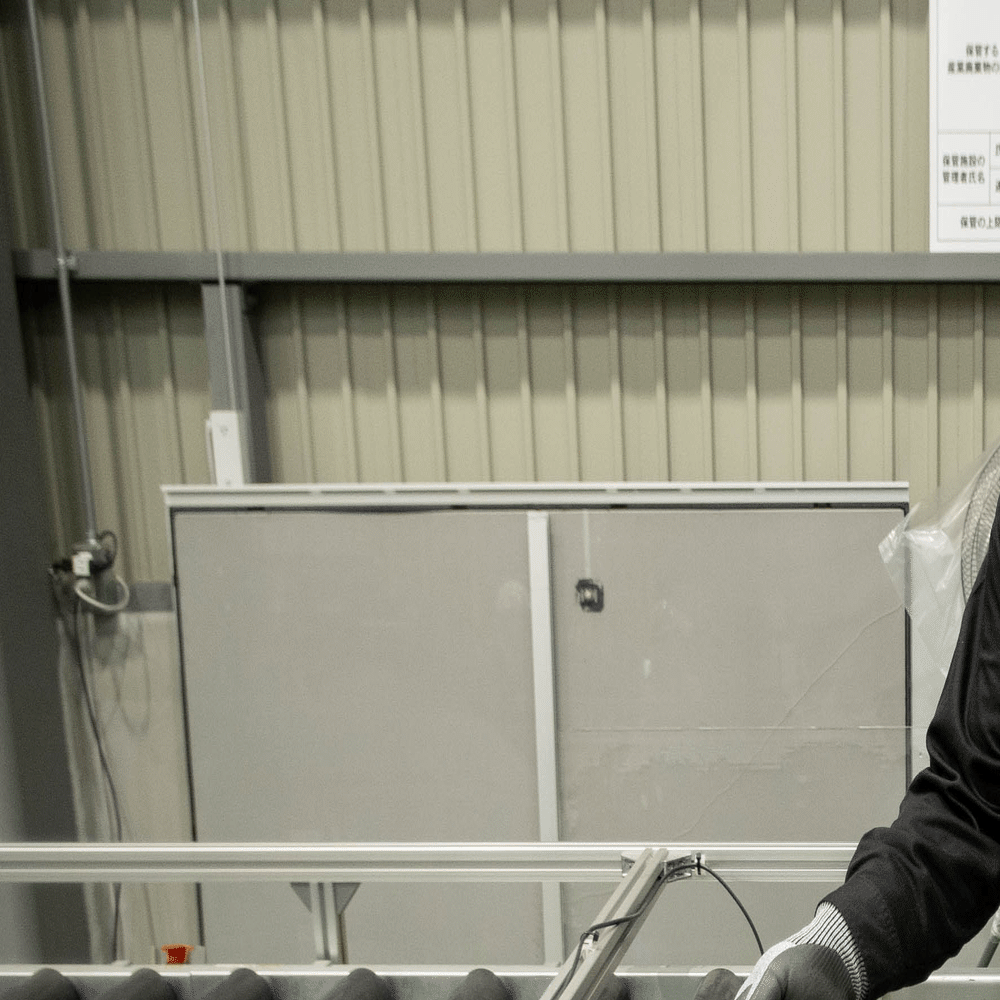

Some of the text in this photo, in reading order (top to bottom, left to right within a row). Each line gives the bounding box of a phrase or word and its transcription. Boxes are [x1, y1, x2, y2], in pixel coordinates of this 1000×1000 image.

[966, 43, 999, 58] 保管する
[942, 154, 986, 168] 保管施設の
[942, 171, 985, 184] 管理者氏名
